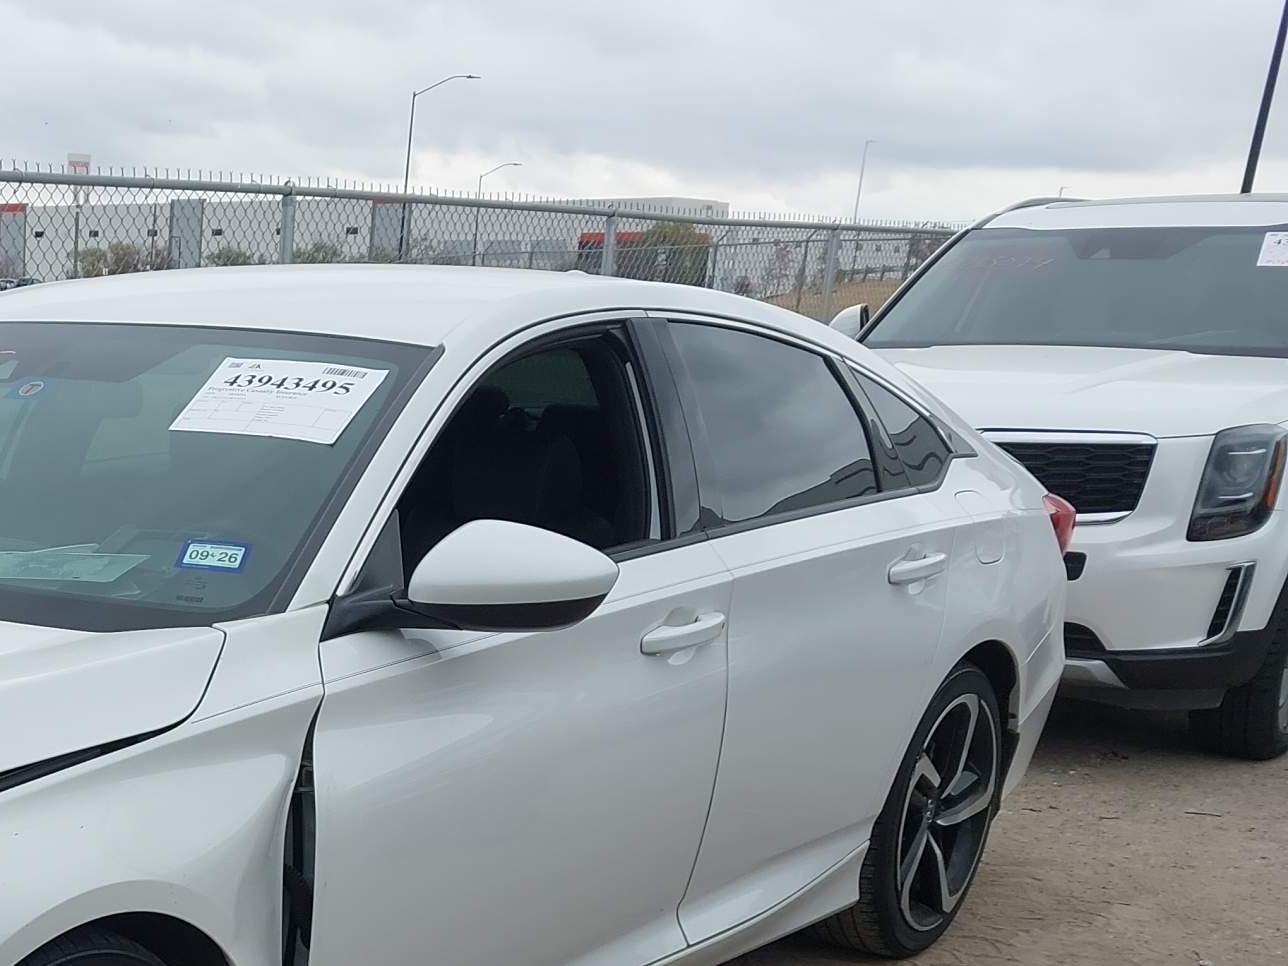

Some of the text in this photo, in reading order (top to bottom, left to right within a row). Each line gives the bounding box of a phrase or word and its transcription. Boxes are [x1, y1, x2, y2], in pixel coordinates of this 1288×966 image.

[224, 374, 355, 395] 43943495
[189, 549, 239, 563] 09 26
